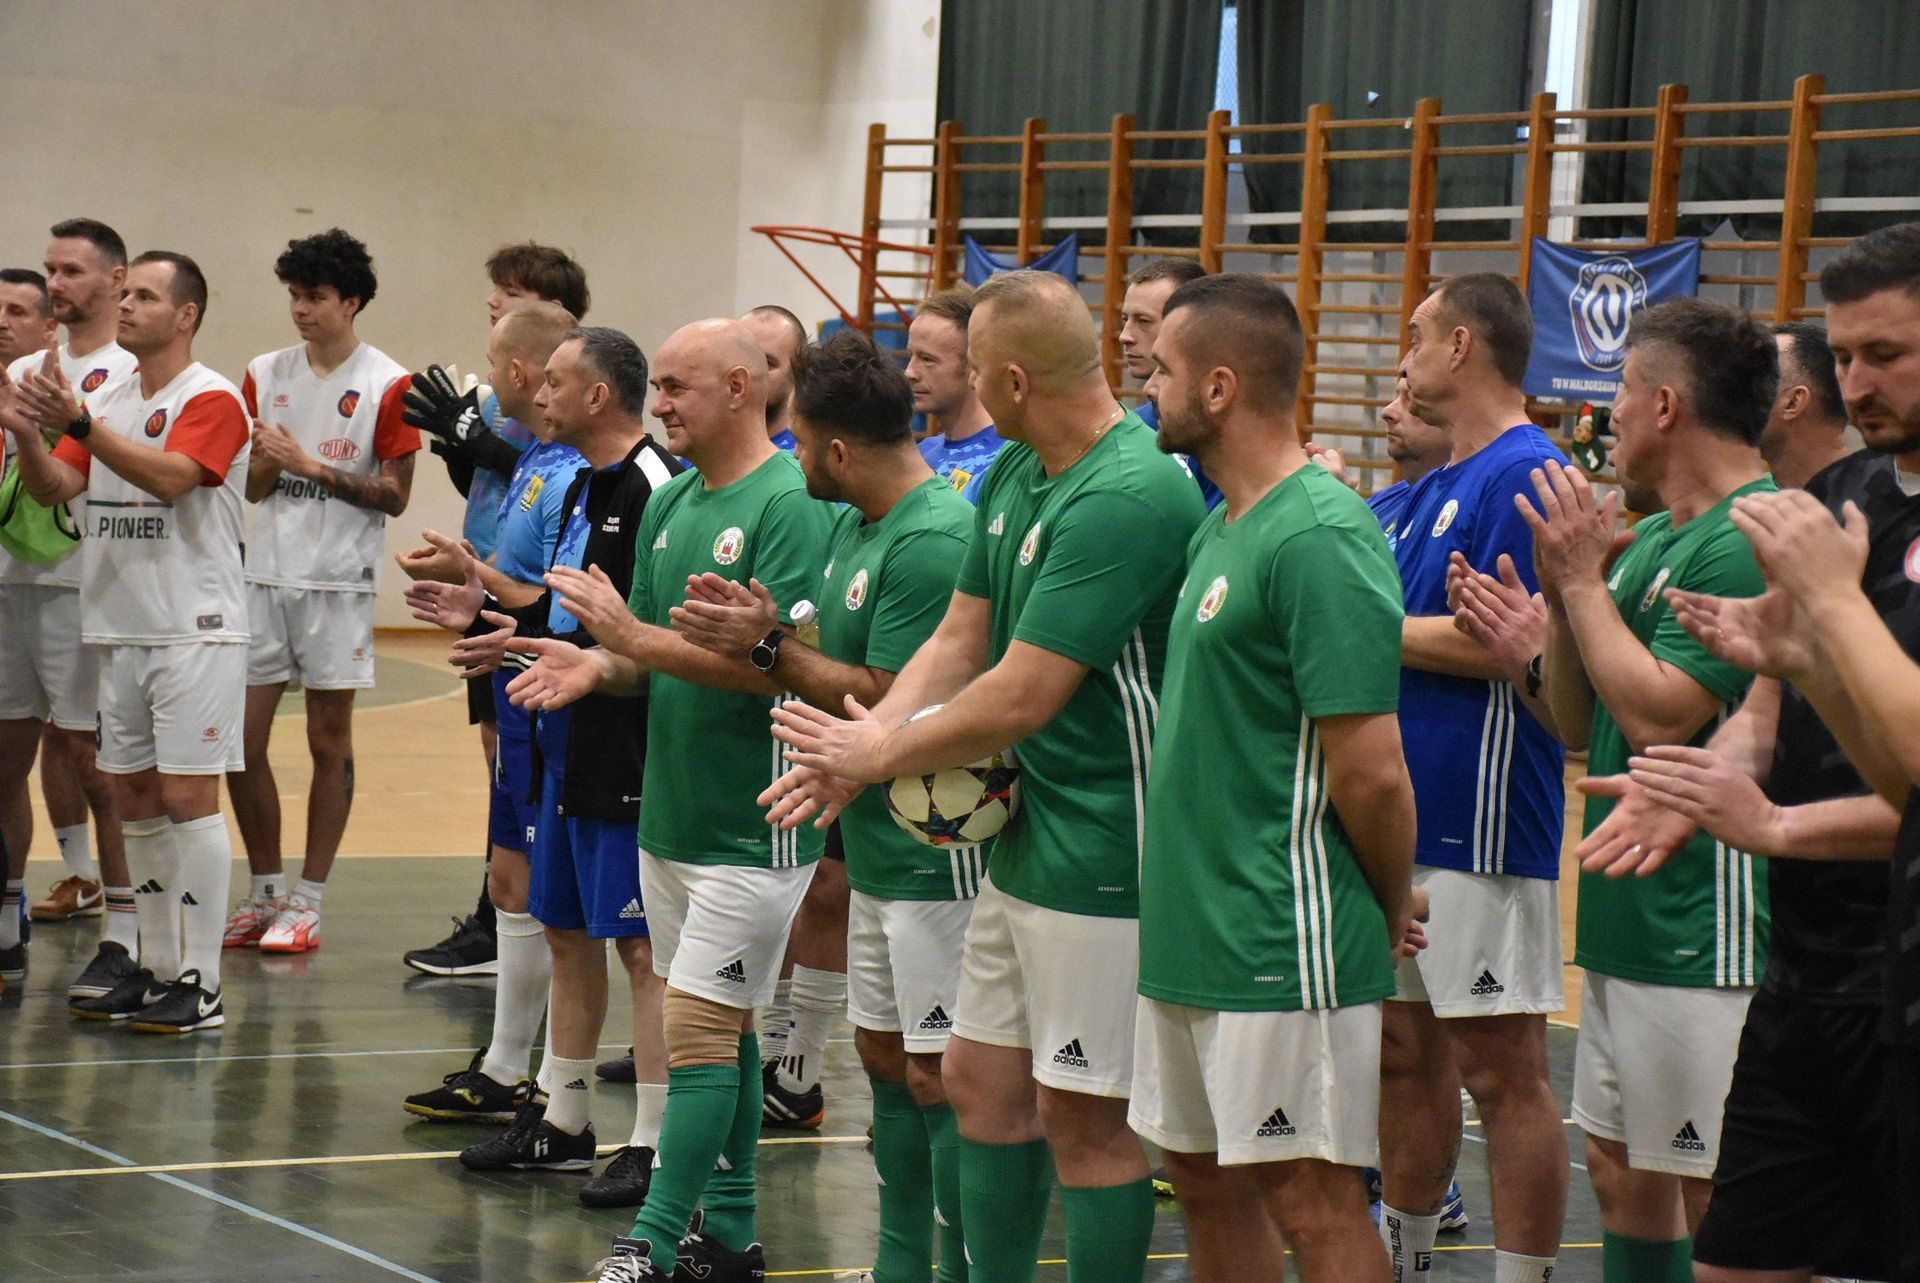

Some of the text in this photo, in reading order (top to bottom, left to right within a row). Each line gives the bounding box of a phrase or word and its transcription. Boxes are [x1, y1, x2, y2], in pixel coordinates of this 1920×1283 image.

[619, 911, 645, 919] adidas
[716, 969, 746, 983] adidas
[1471, 984, 1504, 995] adidas
[919, 1019, 953, 1029] adidas
[1053, 1054, 1088, 1068] adidas
[1257, 1124, 1296, 1137] adidas
[1672, 1139, 1706, 1151] adidas
